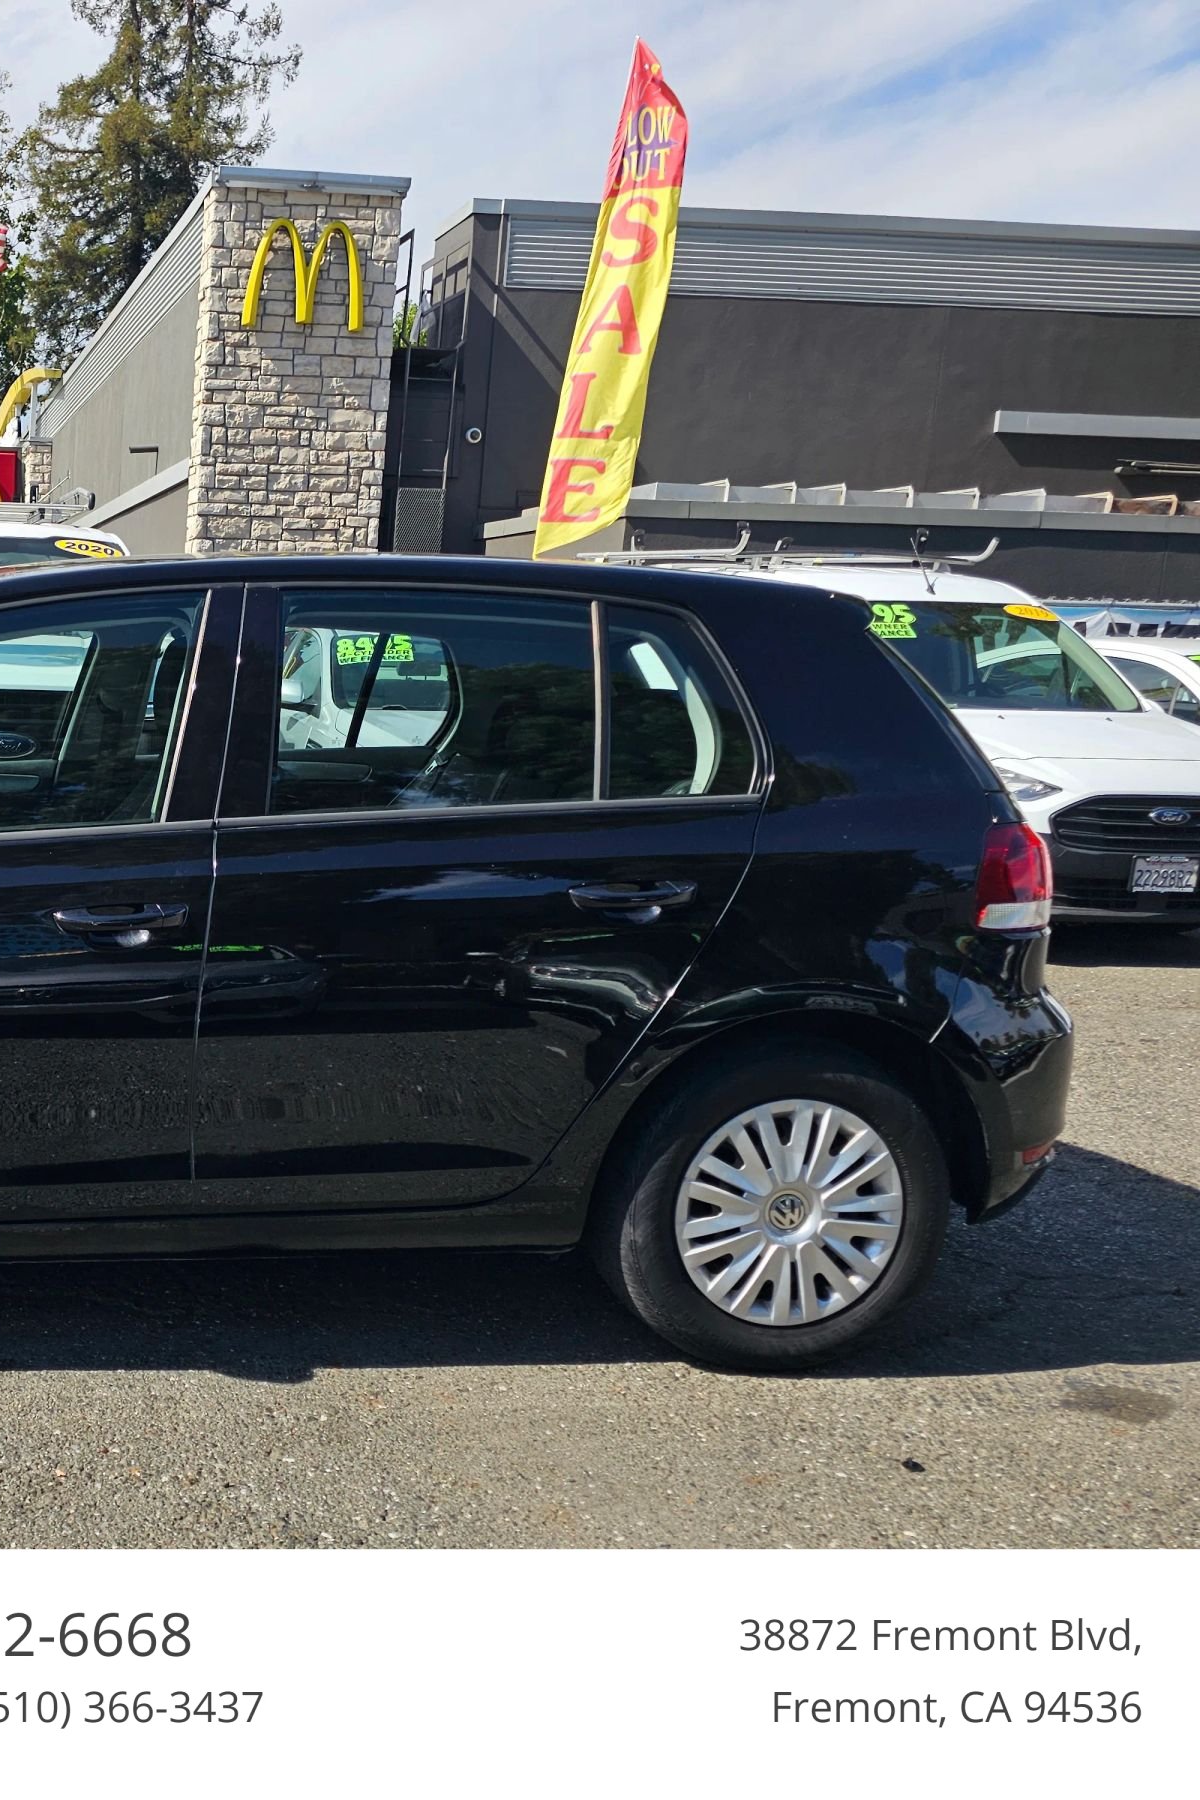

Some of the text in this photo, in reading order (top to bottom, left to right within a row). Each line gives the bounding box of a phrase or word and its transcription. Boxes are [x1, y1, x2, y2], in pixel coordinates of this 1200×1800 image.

[625, 105, 677, 149] LOW
[541, 197, 661, 523] SALE
[65, 541, 114, 556] 2020
[871, 604, 917, 623] 95
[336, 634, 413, 653] 845
[339, 650, 410, 658] 4-CYLDER
[360, 654, 412, 662] FINCE
